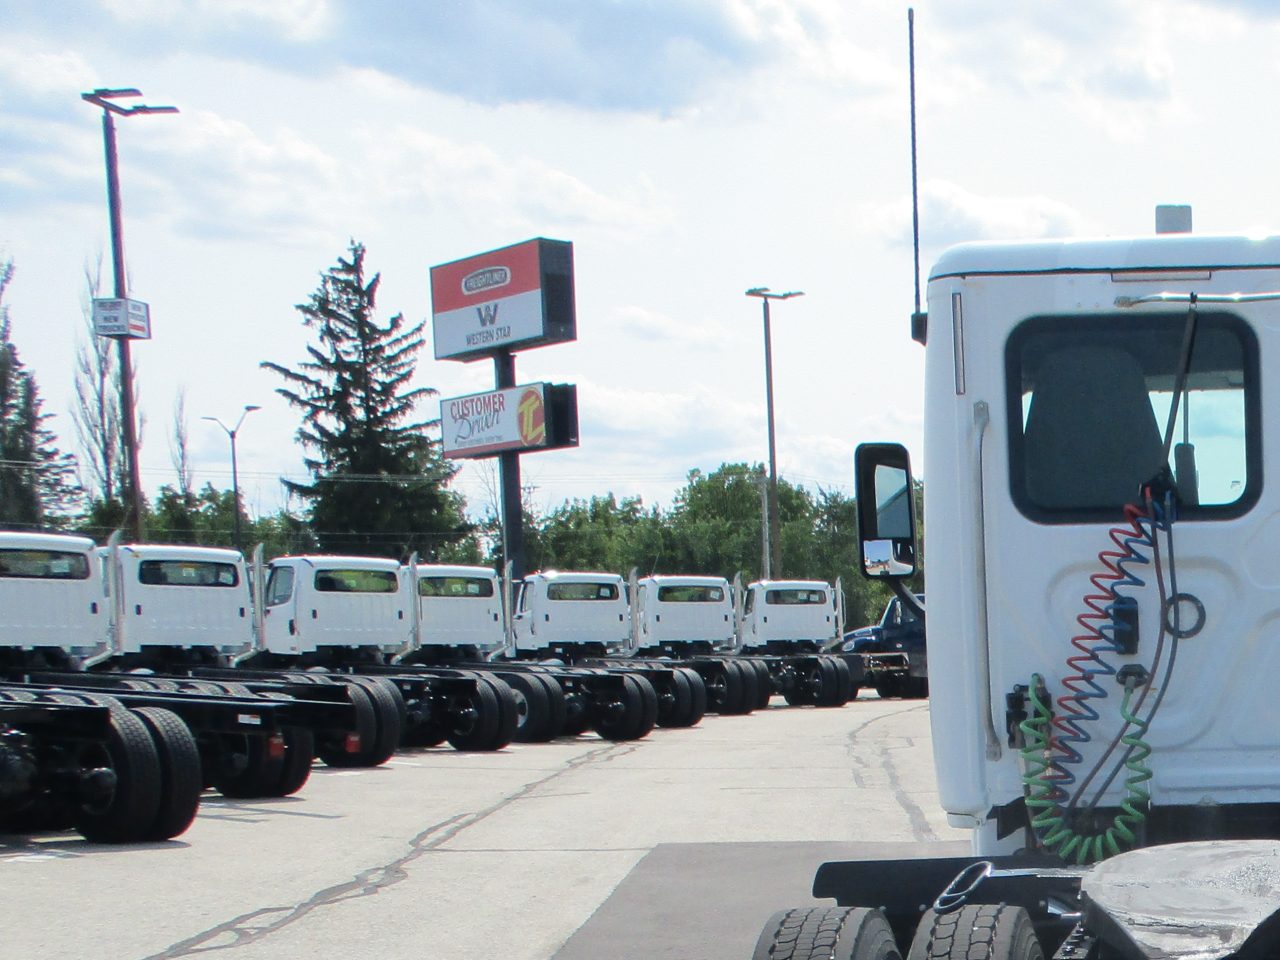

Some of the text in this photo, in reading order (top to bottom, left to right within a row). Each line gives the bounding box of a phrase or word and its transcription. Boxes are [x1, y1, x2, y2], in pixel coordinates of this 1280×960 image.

[466, 326, 511, 346] WESTERN STAR
[450, 393, 505, 421] CUSTOMER
